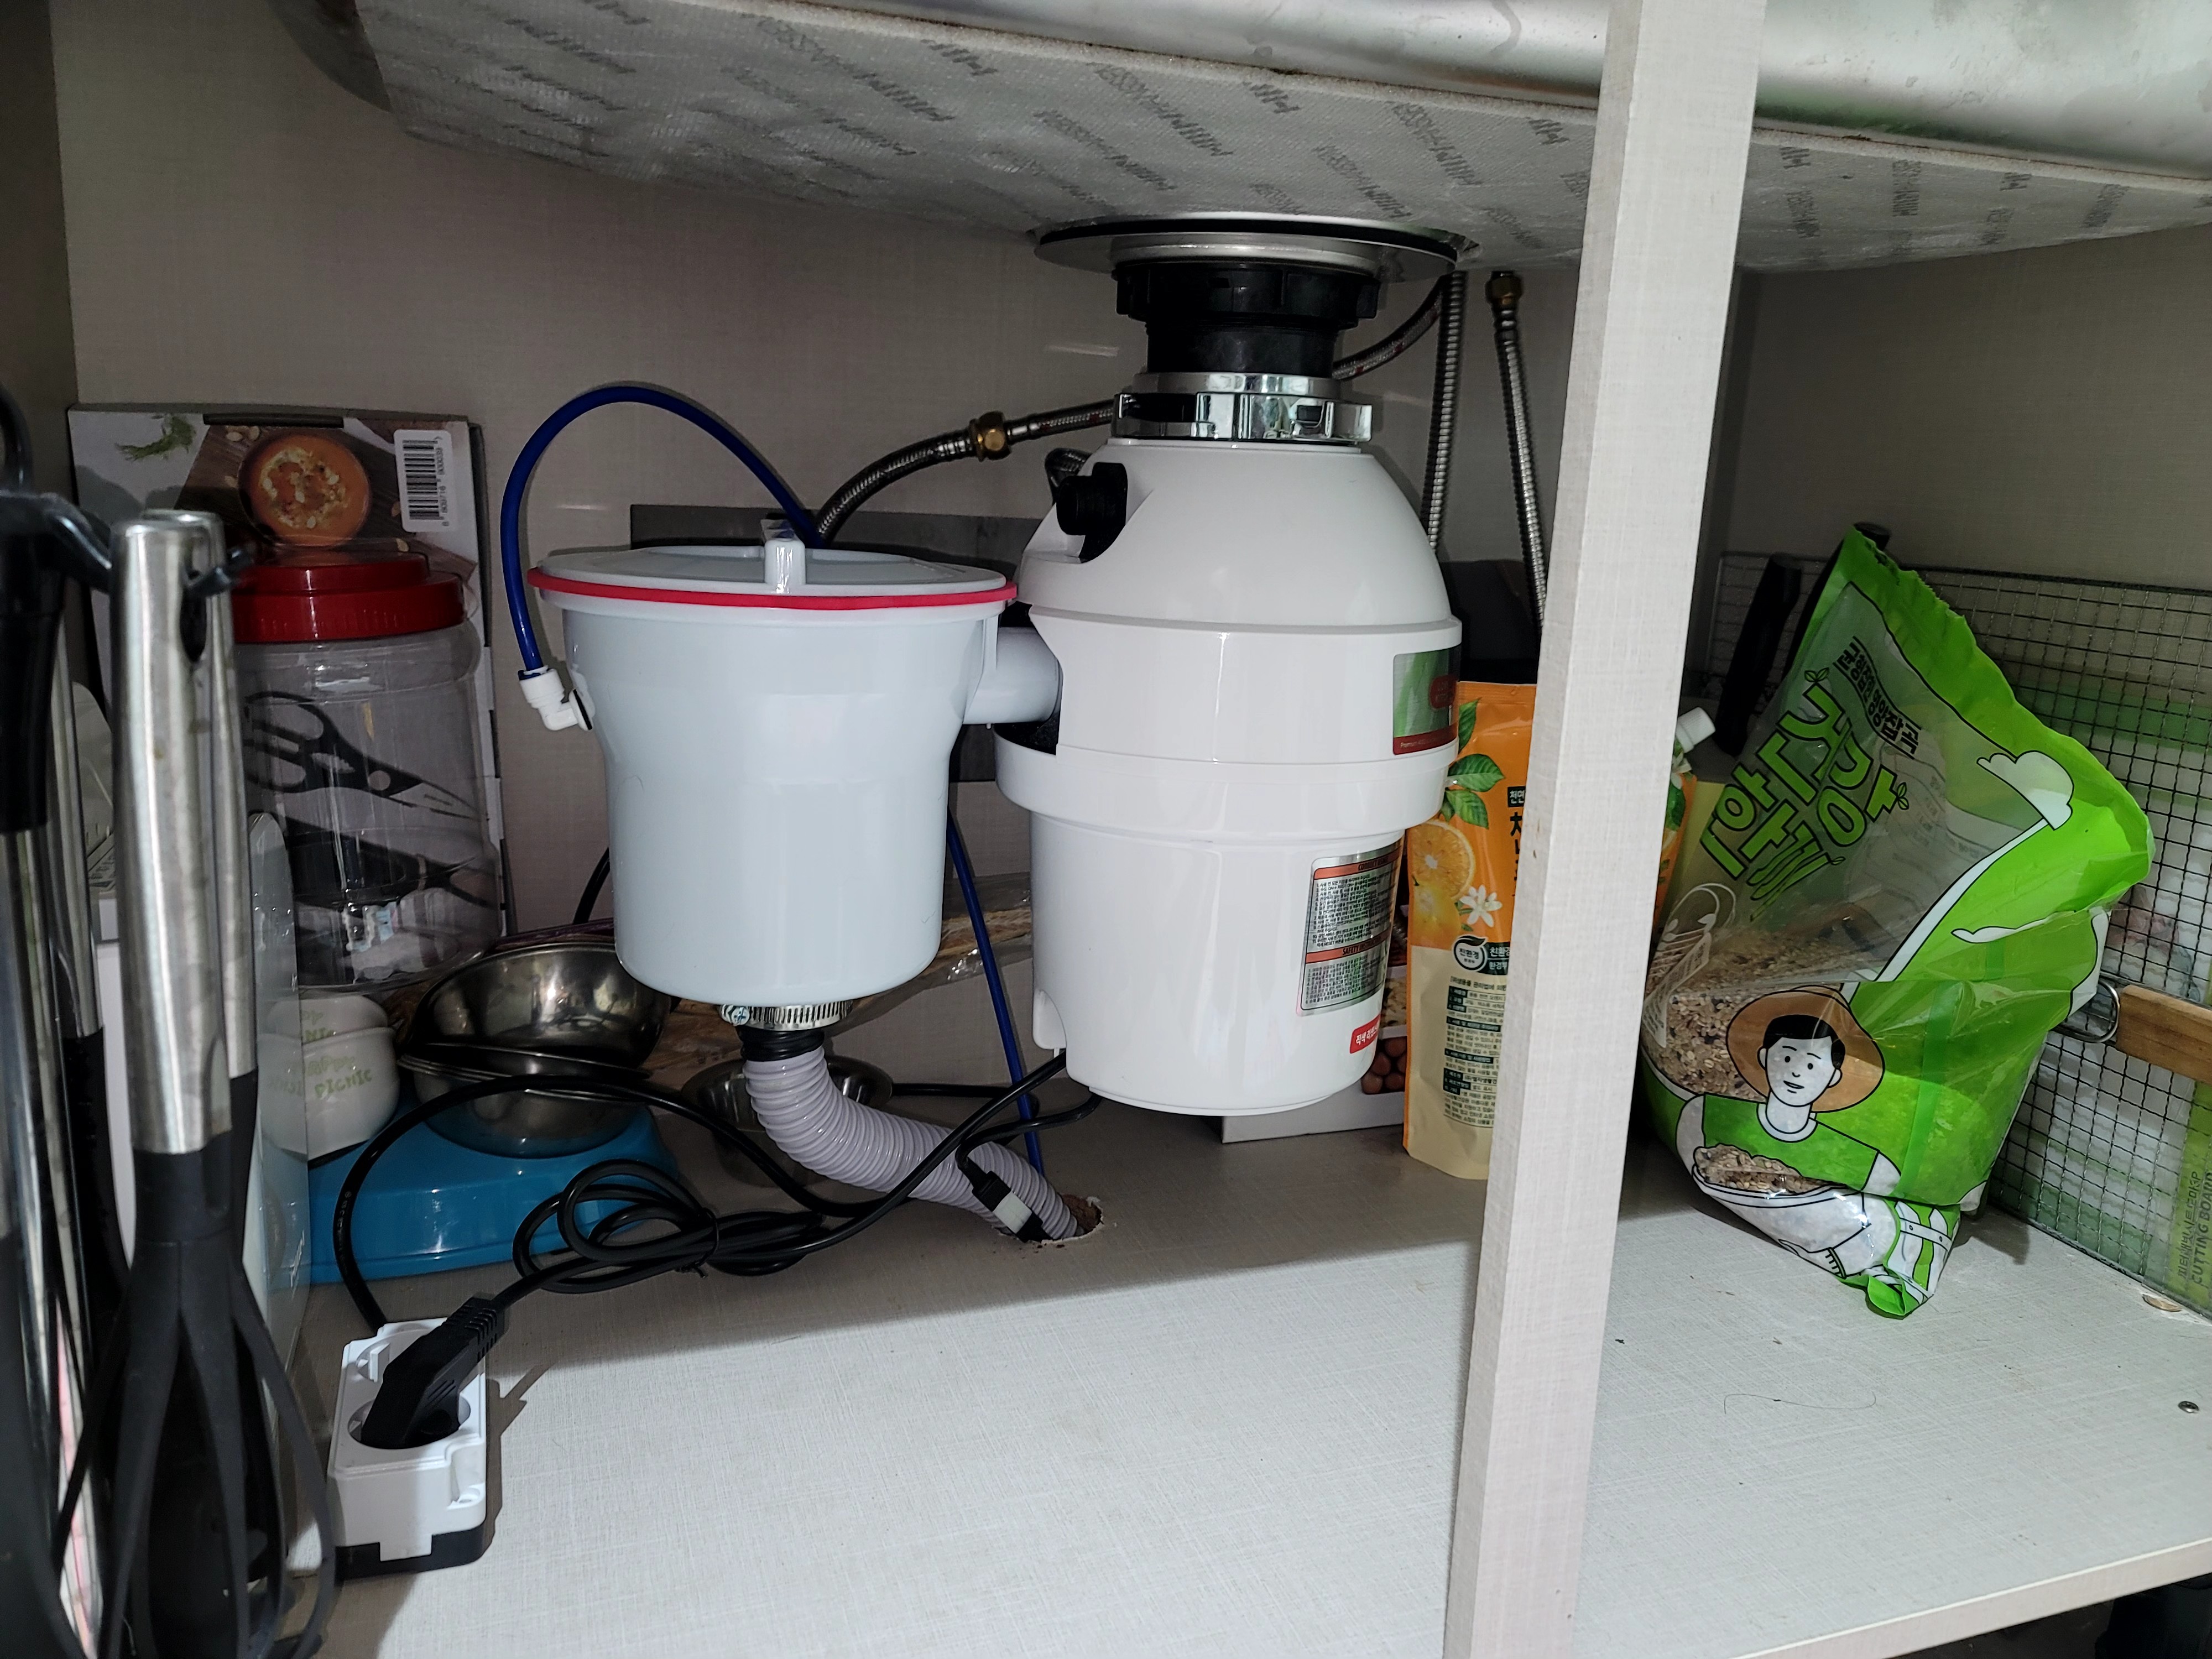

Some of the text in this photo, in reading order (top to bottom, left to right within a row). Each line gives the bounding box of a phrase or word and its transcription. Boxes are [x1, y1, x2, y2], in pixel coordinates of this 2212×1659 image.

[1867, 688, 1919, 754] 영양잡곡
[1756, 682, 1898, 848] 건강
[1700, 764, 1831, 922] 한끼
[1342, 945, 1359, 956] SAFETY
[315, 1069, 372, 1099] PICNIC
[2192, 1224, 2209, 1284] CUTTING
